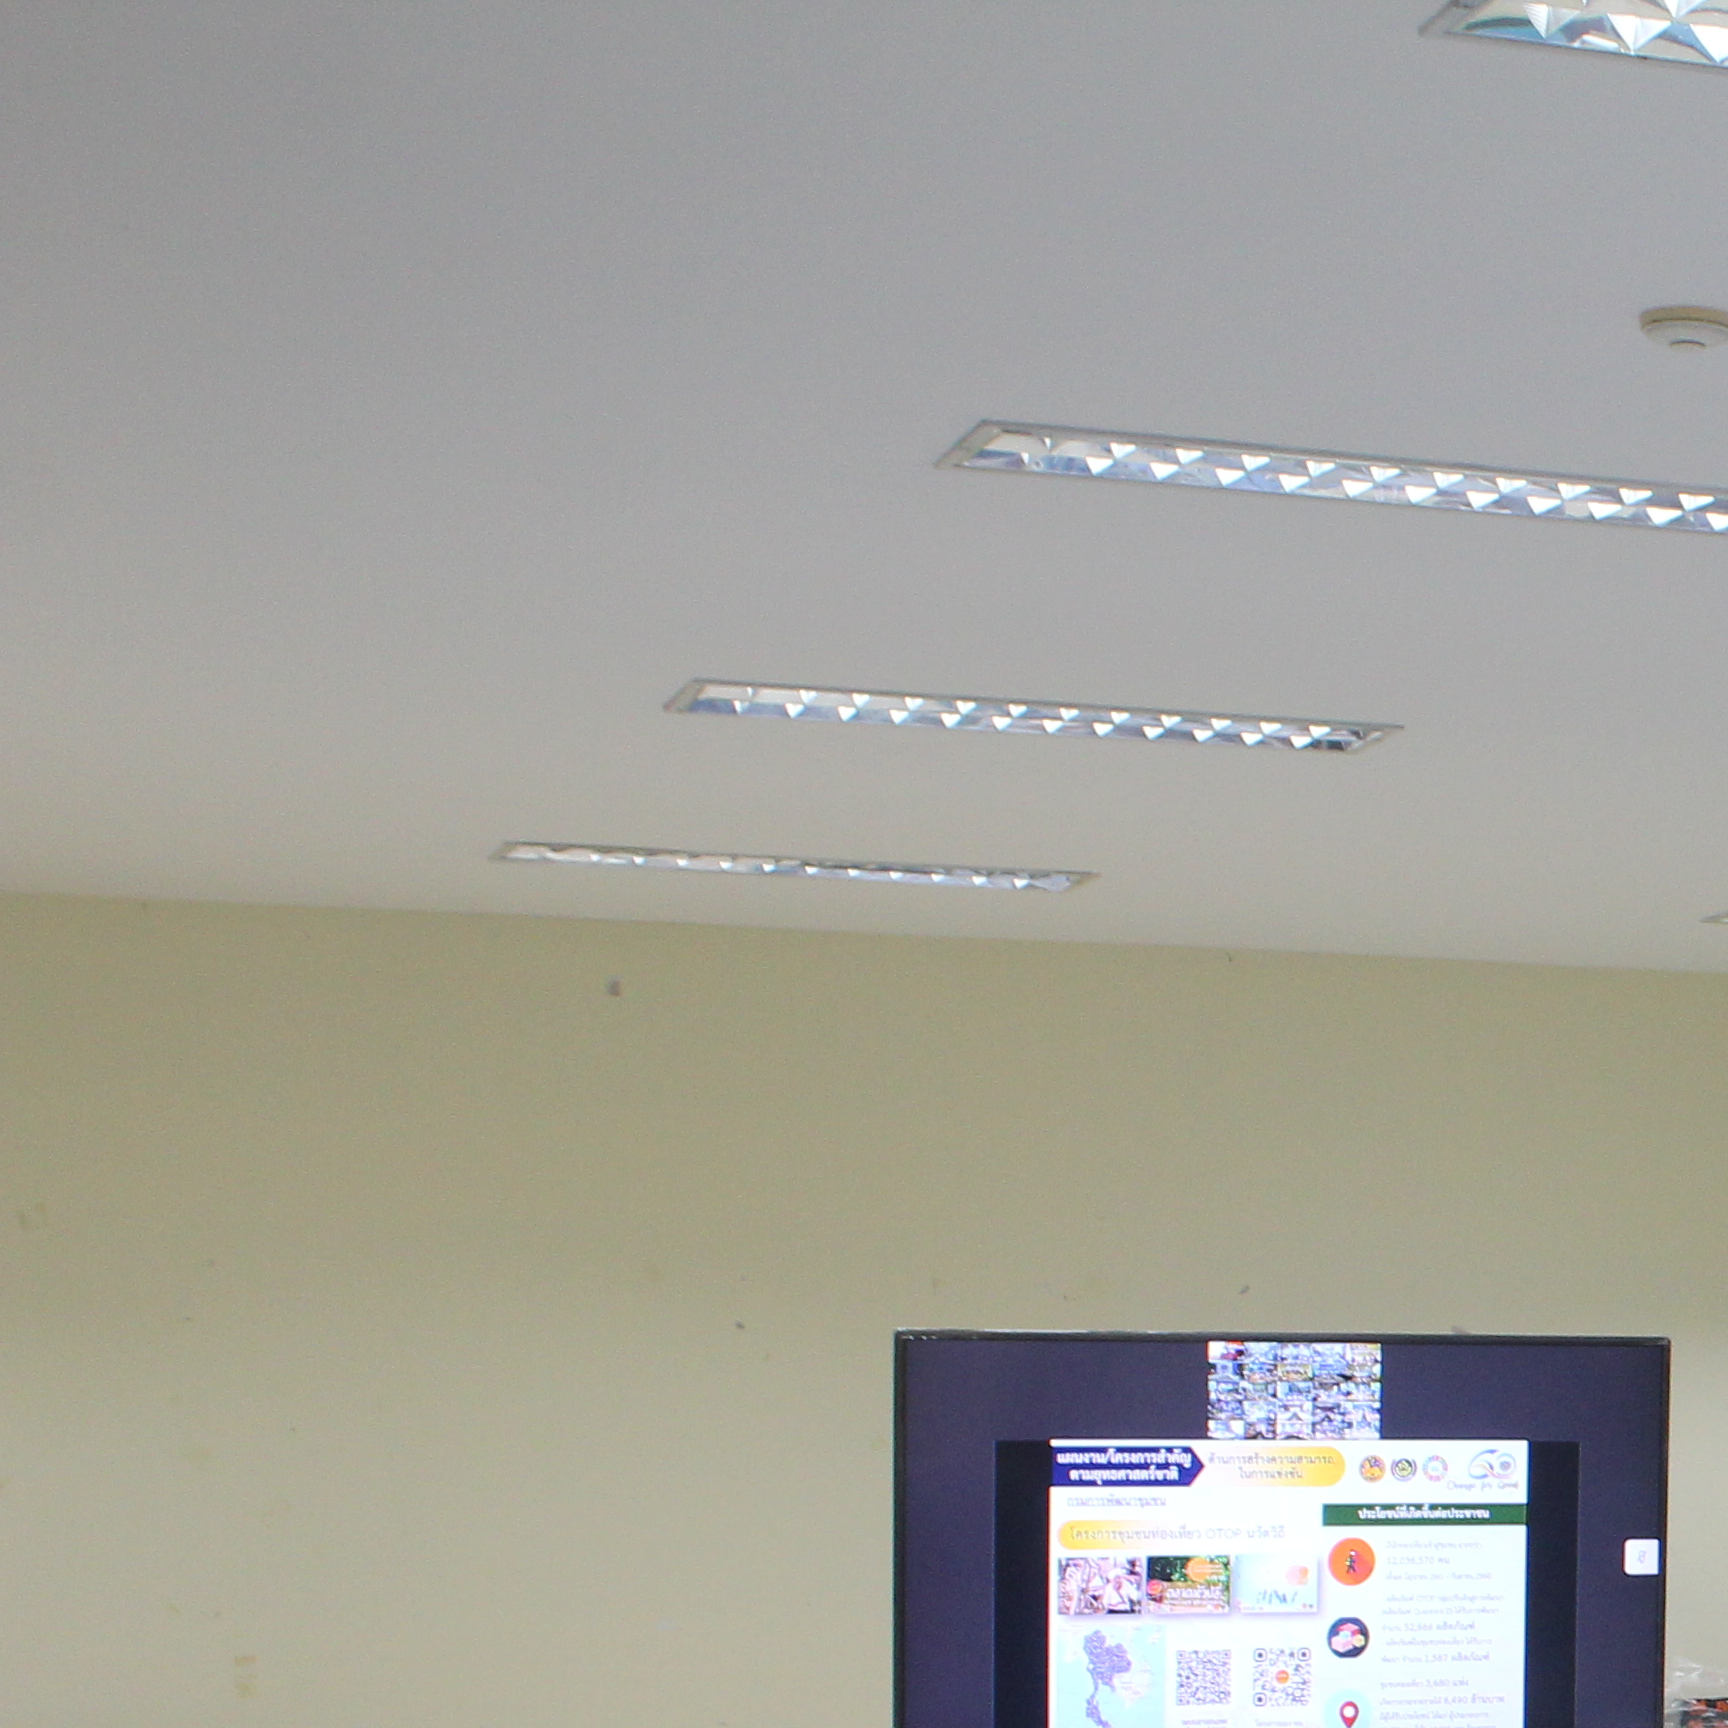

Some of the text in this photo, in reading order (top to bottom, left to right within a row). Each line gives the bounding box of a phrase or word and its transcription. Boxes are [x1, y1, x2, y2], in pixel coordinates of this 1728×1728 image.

[1056, 1447, 1192, 1467] แผนงาน/โครงการสำคัญ
[1068, 1466, 1180, 1485] ตามยุทธศาสตร์ชาติ
[1205, 1527, 1243, 1540] OTOP
